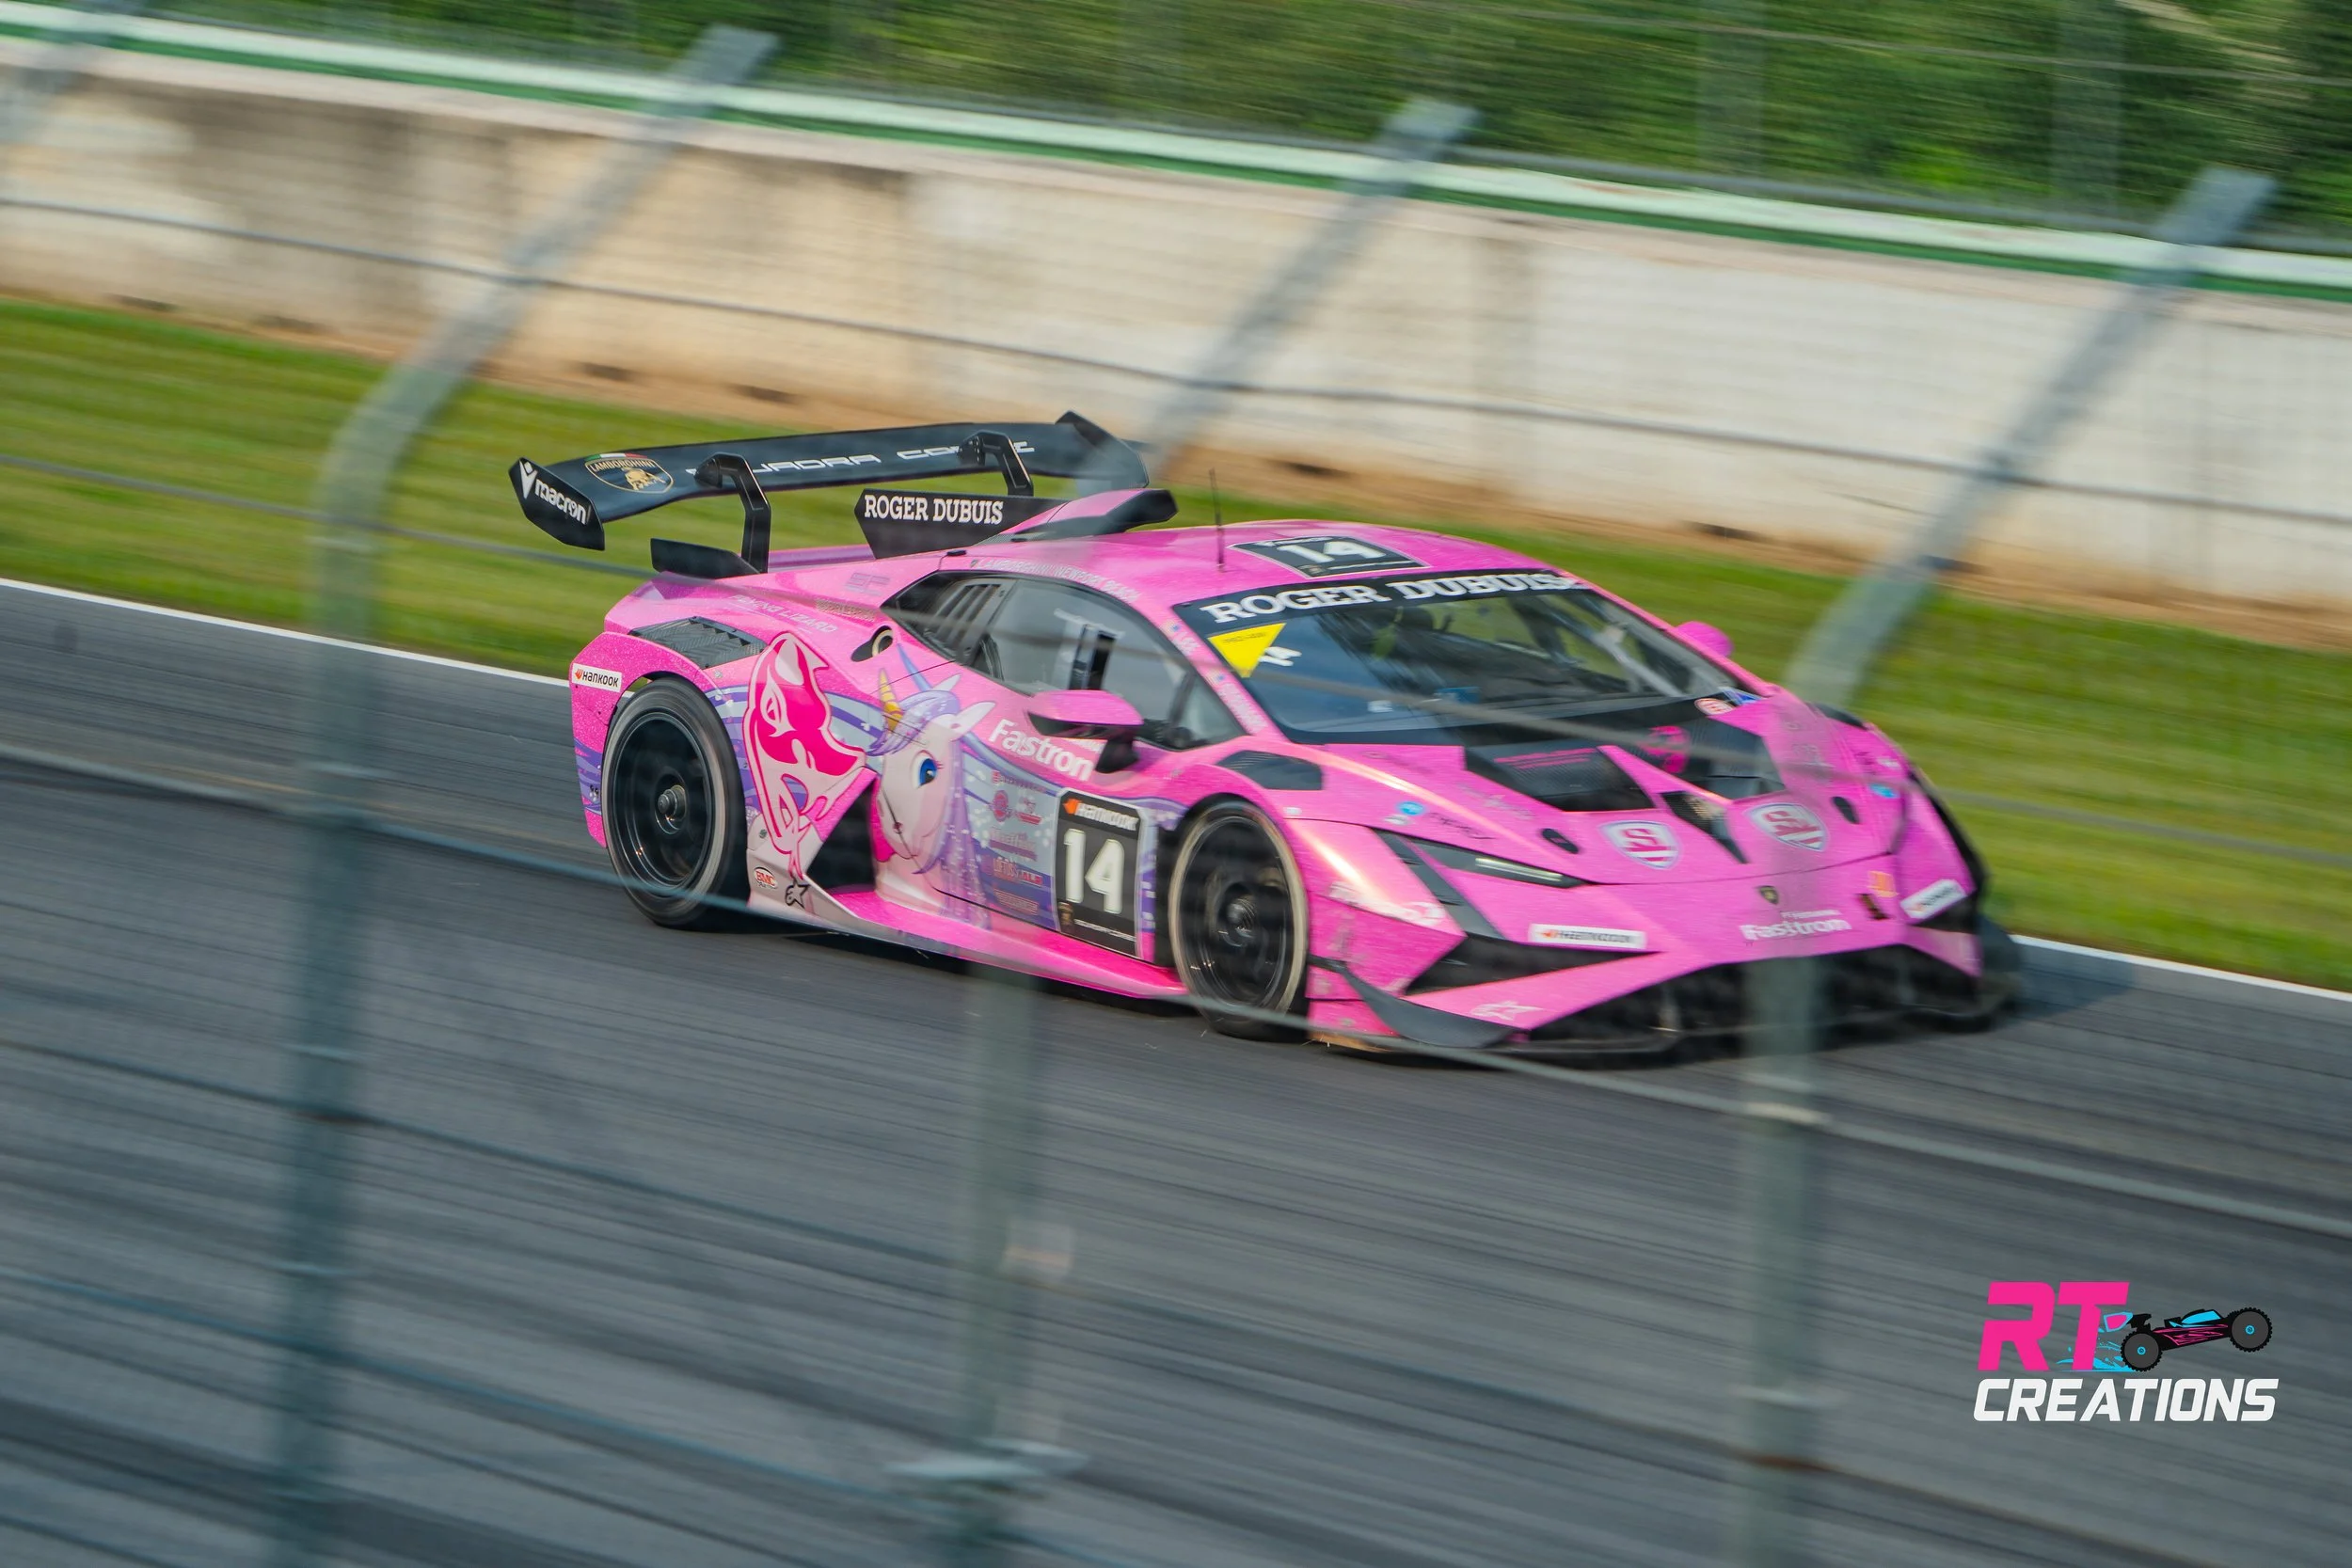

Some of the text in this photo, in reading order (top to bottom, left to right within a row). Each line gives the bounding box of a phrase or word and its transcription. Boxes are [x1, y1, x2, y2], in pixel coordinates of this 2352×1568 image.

[534, 481, 588, 524] macron
[864, 495, 1004, 524] ROGER DUBUIS
[1277, 541, 1386, 562] 14
[1200, 573, 1575, 624] ROGER DUBUIS
[779, 610, 838, 633] LIZARD
[989, 719, 1094, 782] Fastron
[1063, 828, 1125, 914] 14
